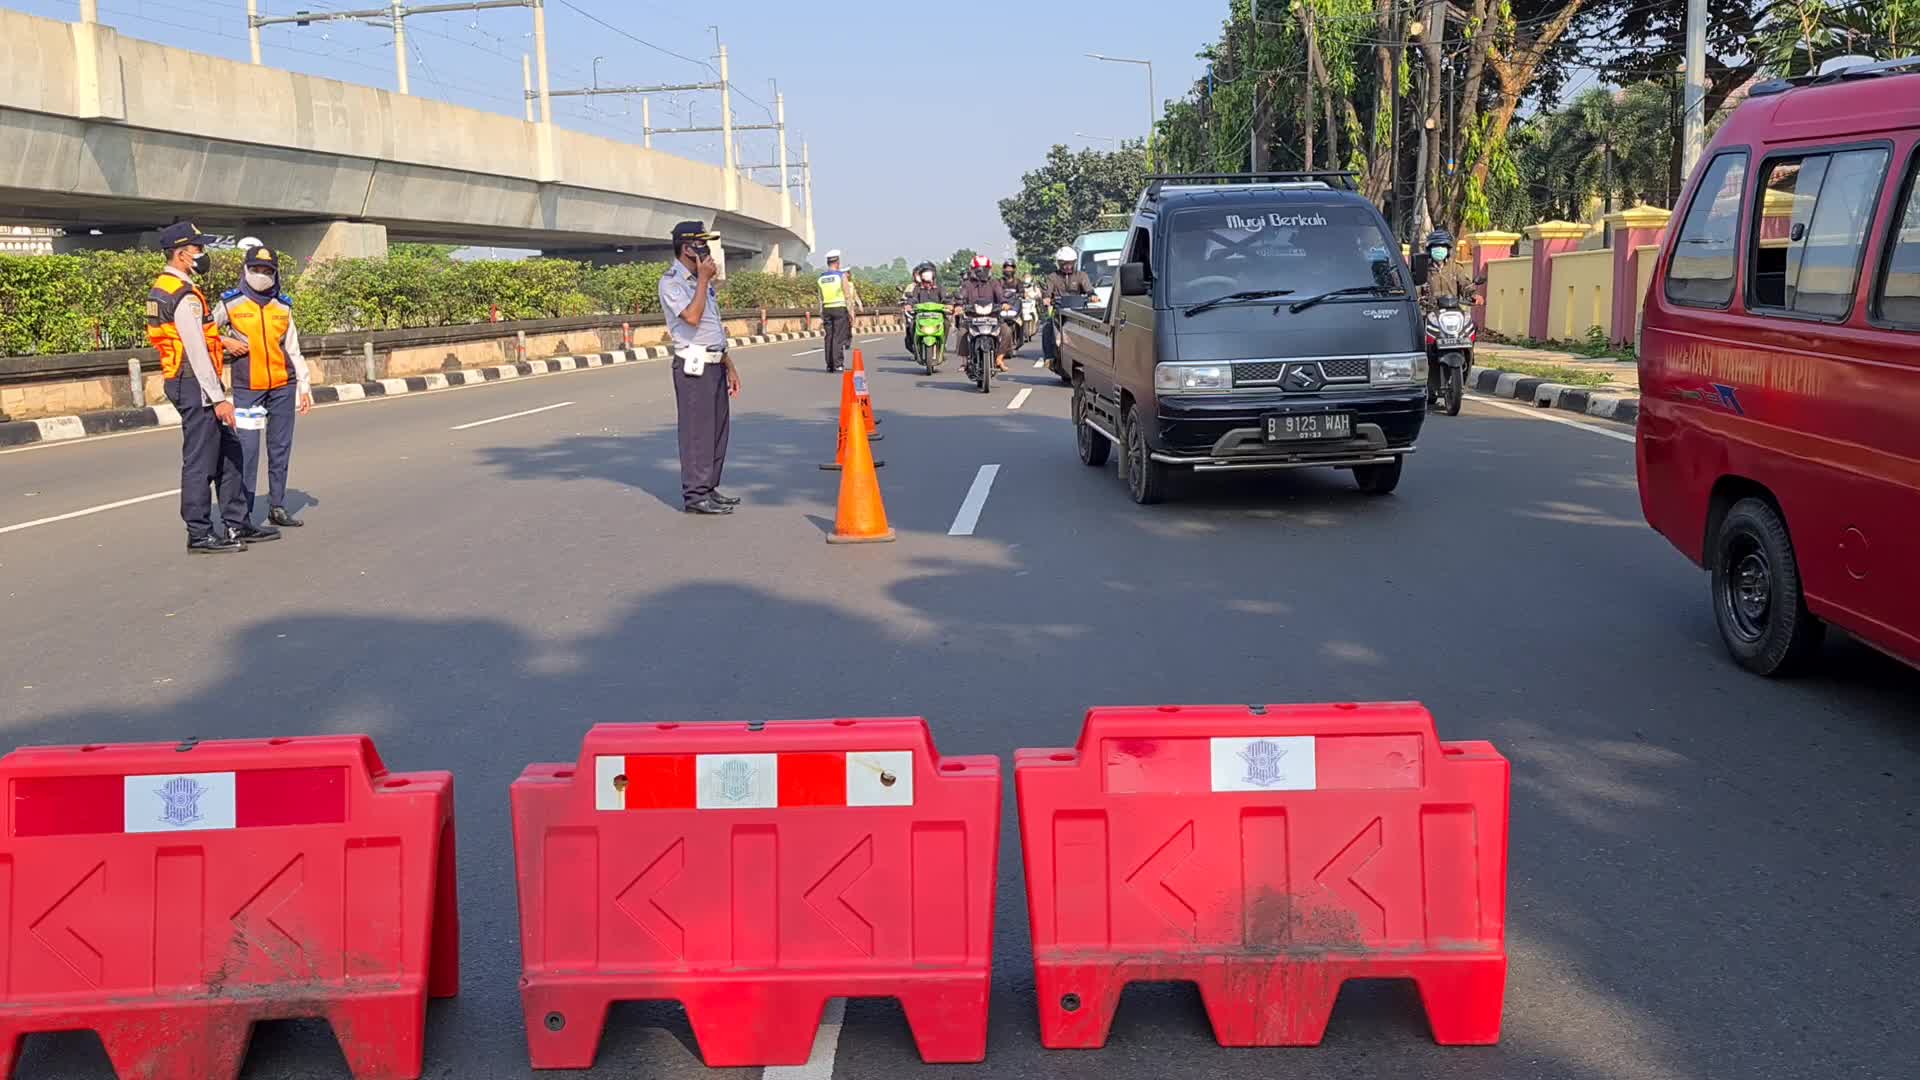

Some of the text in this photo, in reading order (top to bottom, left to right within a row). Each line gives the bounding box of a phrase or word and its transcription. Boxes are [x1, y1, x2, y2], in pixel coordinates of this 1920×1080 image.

[1225, 212, 1328, 232] Mugi Berkah
[1268, 414, 1350, 433] B 9125 WAH
